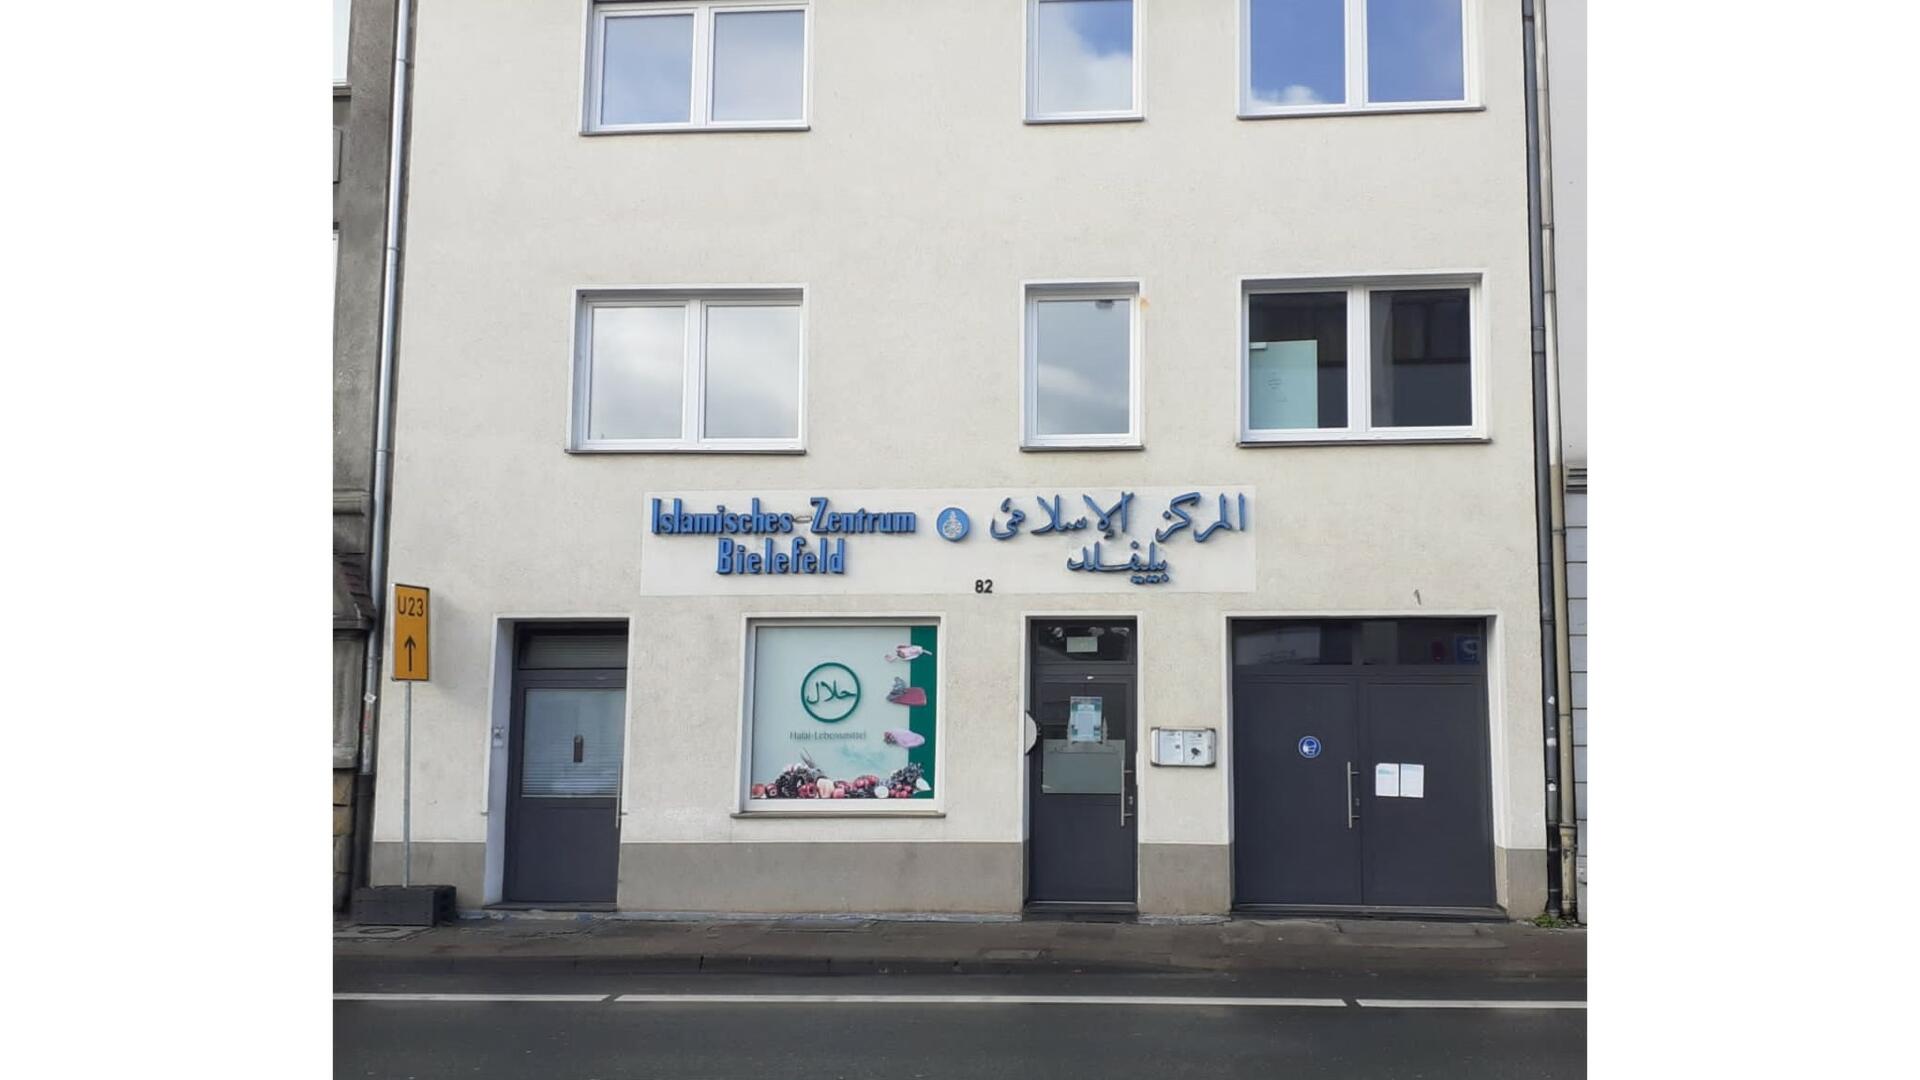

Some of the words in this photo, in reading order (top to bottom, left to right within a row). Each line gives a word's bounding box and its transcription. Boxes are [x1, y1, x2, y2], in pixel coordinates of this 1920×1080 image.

[1155, 491, 1246, 542] المركز
[716, 535, 846, 575] Bielefeld
[975, 578, 993, 594] 82
[397, 595, 425, 617] U23
[806, 679, 857, 705] حلال
